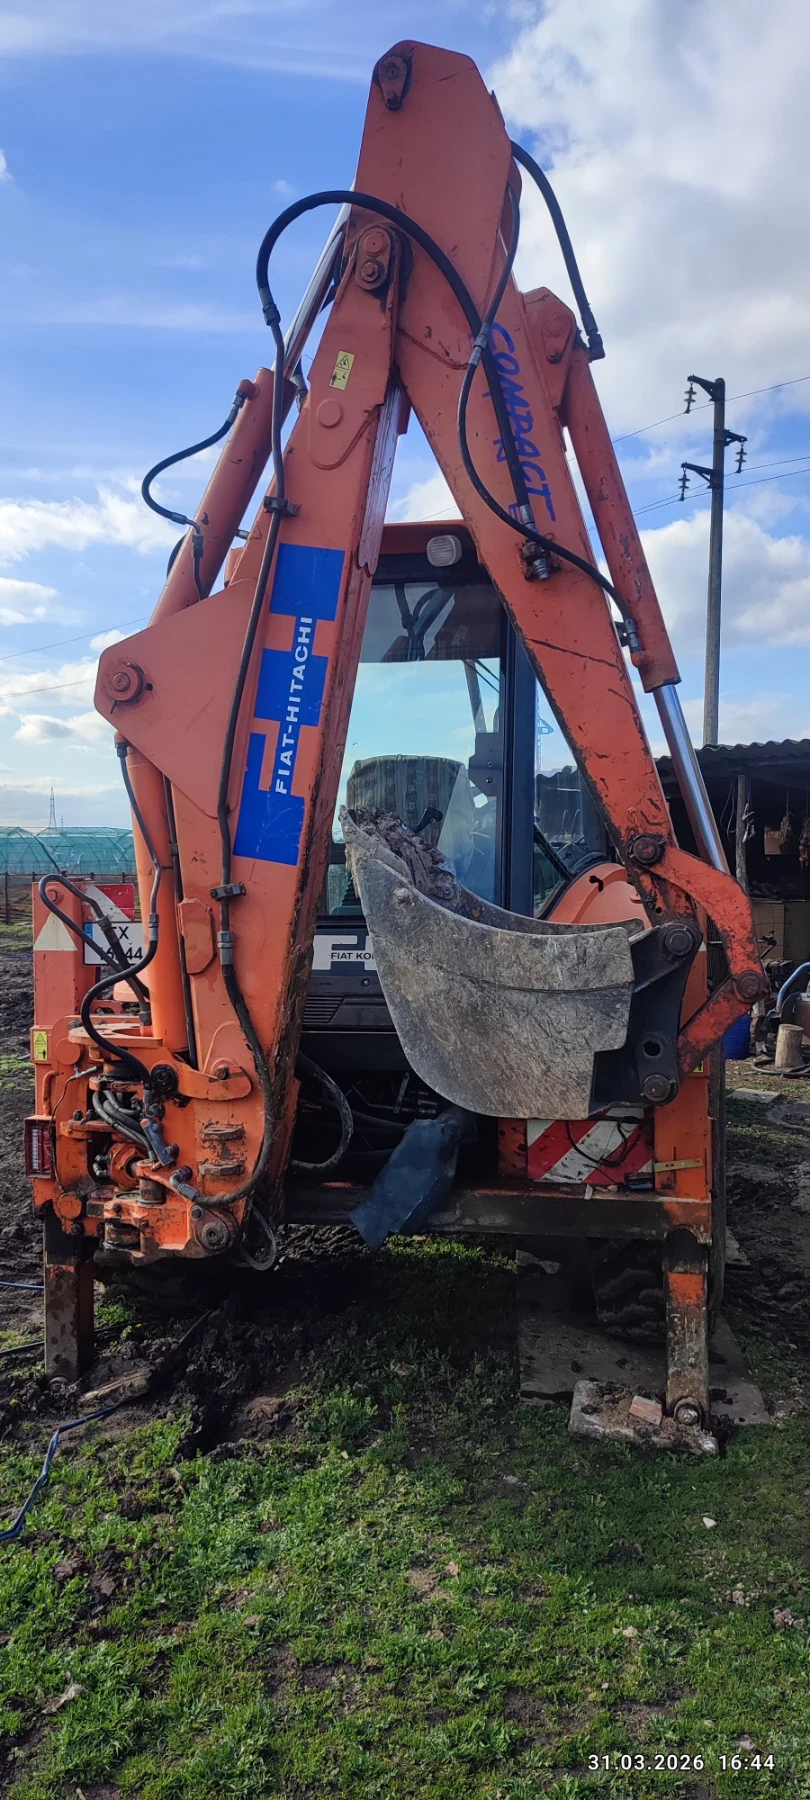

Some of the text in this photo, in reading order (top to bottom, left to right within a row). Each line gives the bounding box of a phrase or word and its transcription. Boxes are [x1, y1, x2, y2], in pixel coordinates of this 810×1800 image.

[275, 616, 313, 795] FIAT-HITACHI
[331, 952, 374, 960] FIAT KO
